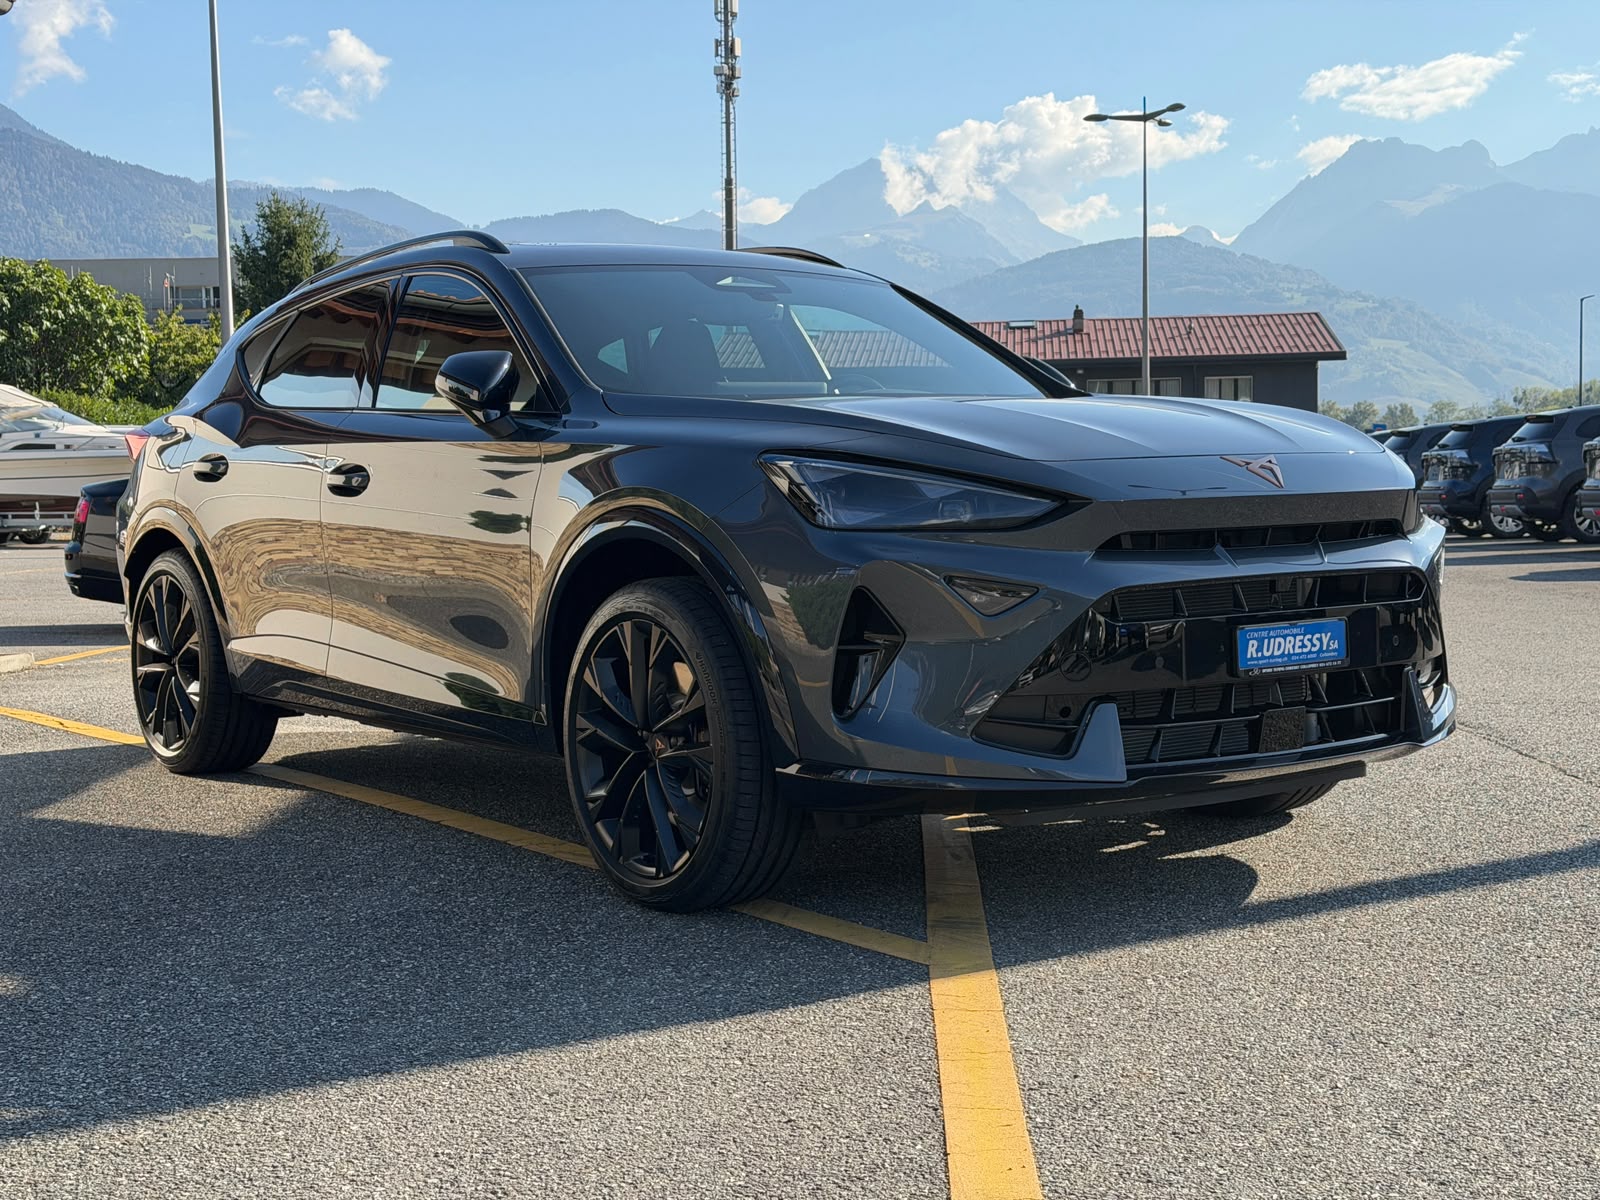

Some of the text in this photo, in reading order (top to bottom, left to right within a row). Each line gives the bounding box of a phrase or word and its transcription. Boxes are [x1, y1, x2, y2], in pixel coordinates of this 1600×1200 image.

[1247, 627, 1305, 639] CENTRE AUTOMOBILE
[1247, 632, 1339, 658] R.UDRESSY SA
